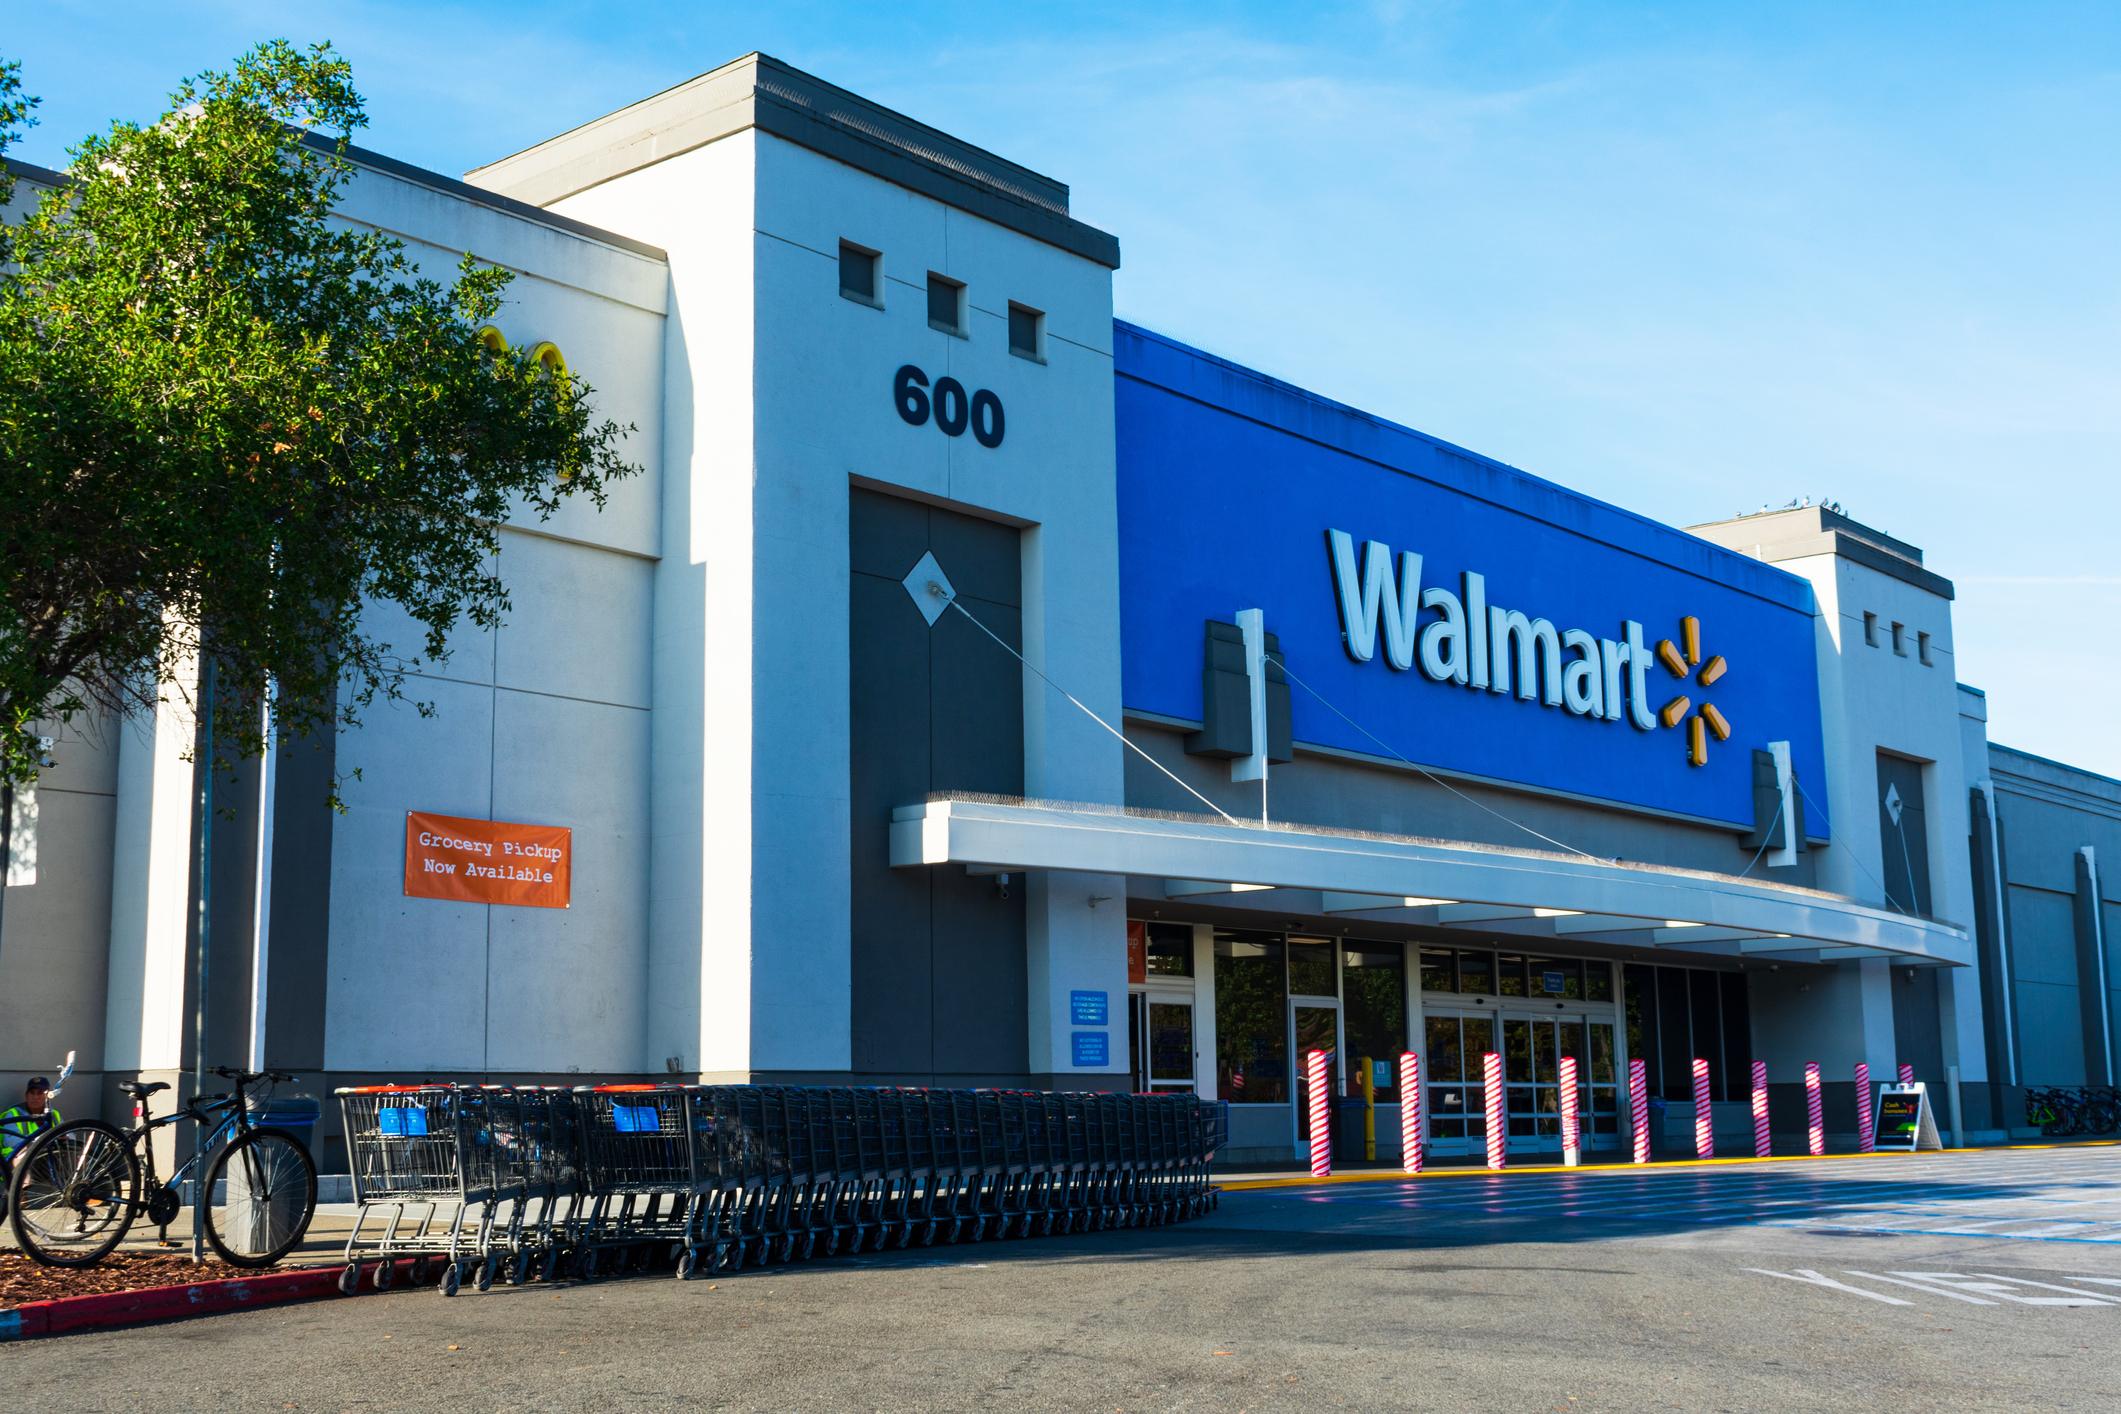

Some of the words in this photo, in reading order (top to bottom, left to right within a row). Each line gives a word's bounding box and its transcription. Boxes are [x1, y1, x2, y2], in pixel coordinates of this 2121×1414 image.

[894, 364, 1005, 448] 600
[1324, 528, 1656, 732] Walmart
[420, 832, 492, 856] Grocery
[503, 842, 562, 862] Pickup
[424, 859, 456, 874] Now
[465, 862, 552, 883] Available
